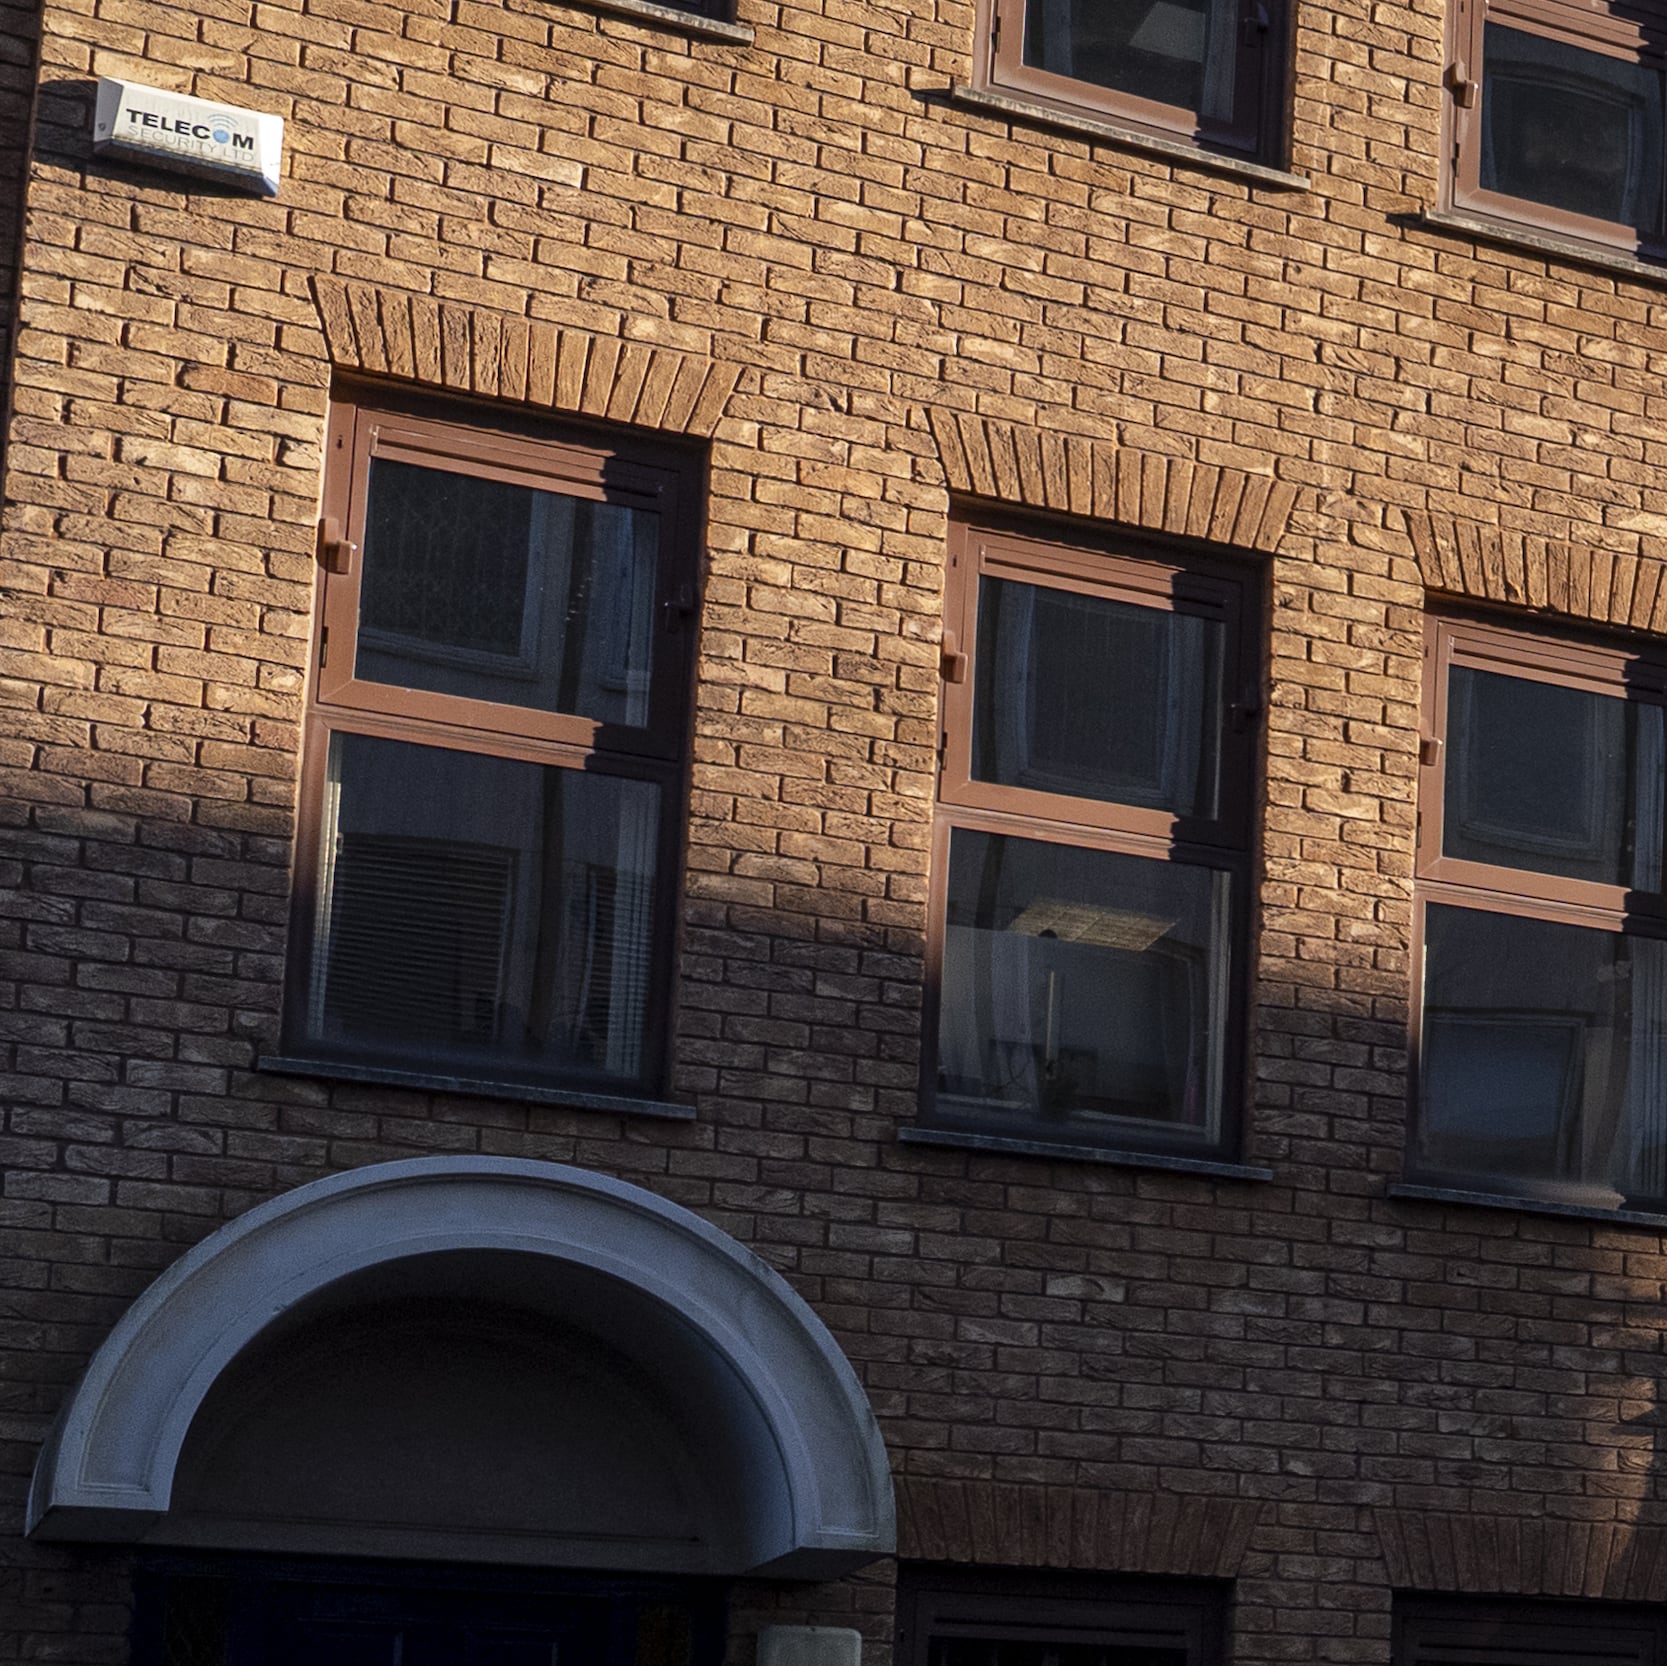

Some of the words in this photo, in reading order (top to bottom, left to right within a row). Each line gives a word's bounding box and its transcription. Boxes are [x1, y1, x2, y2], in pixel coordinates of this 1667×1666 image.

[126, 108, 254, 150] TELECOM
[128, 124, 217, 153] SECURITY
[223, 147, 254, 161] LTD
